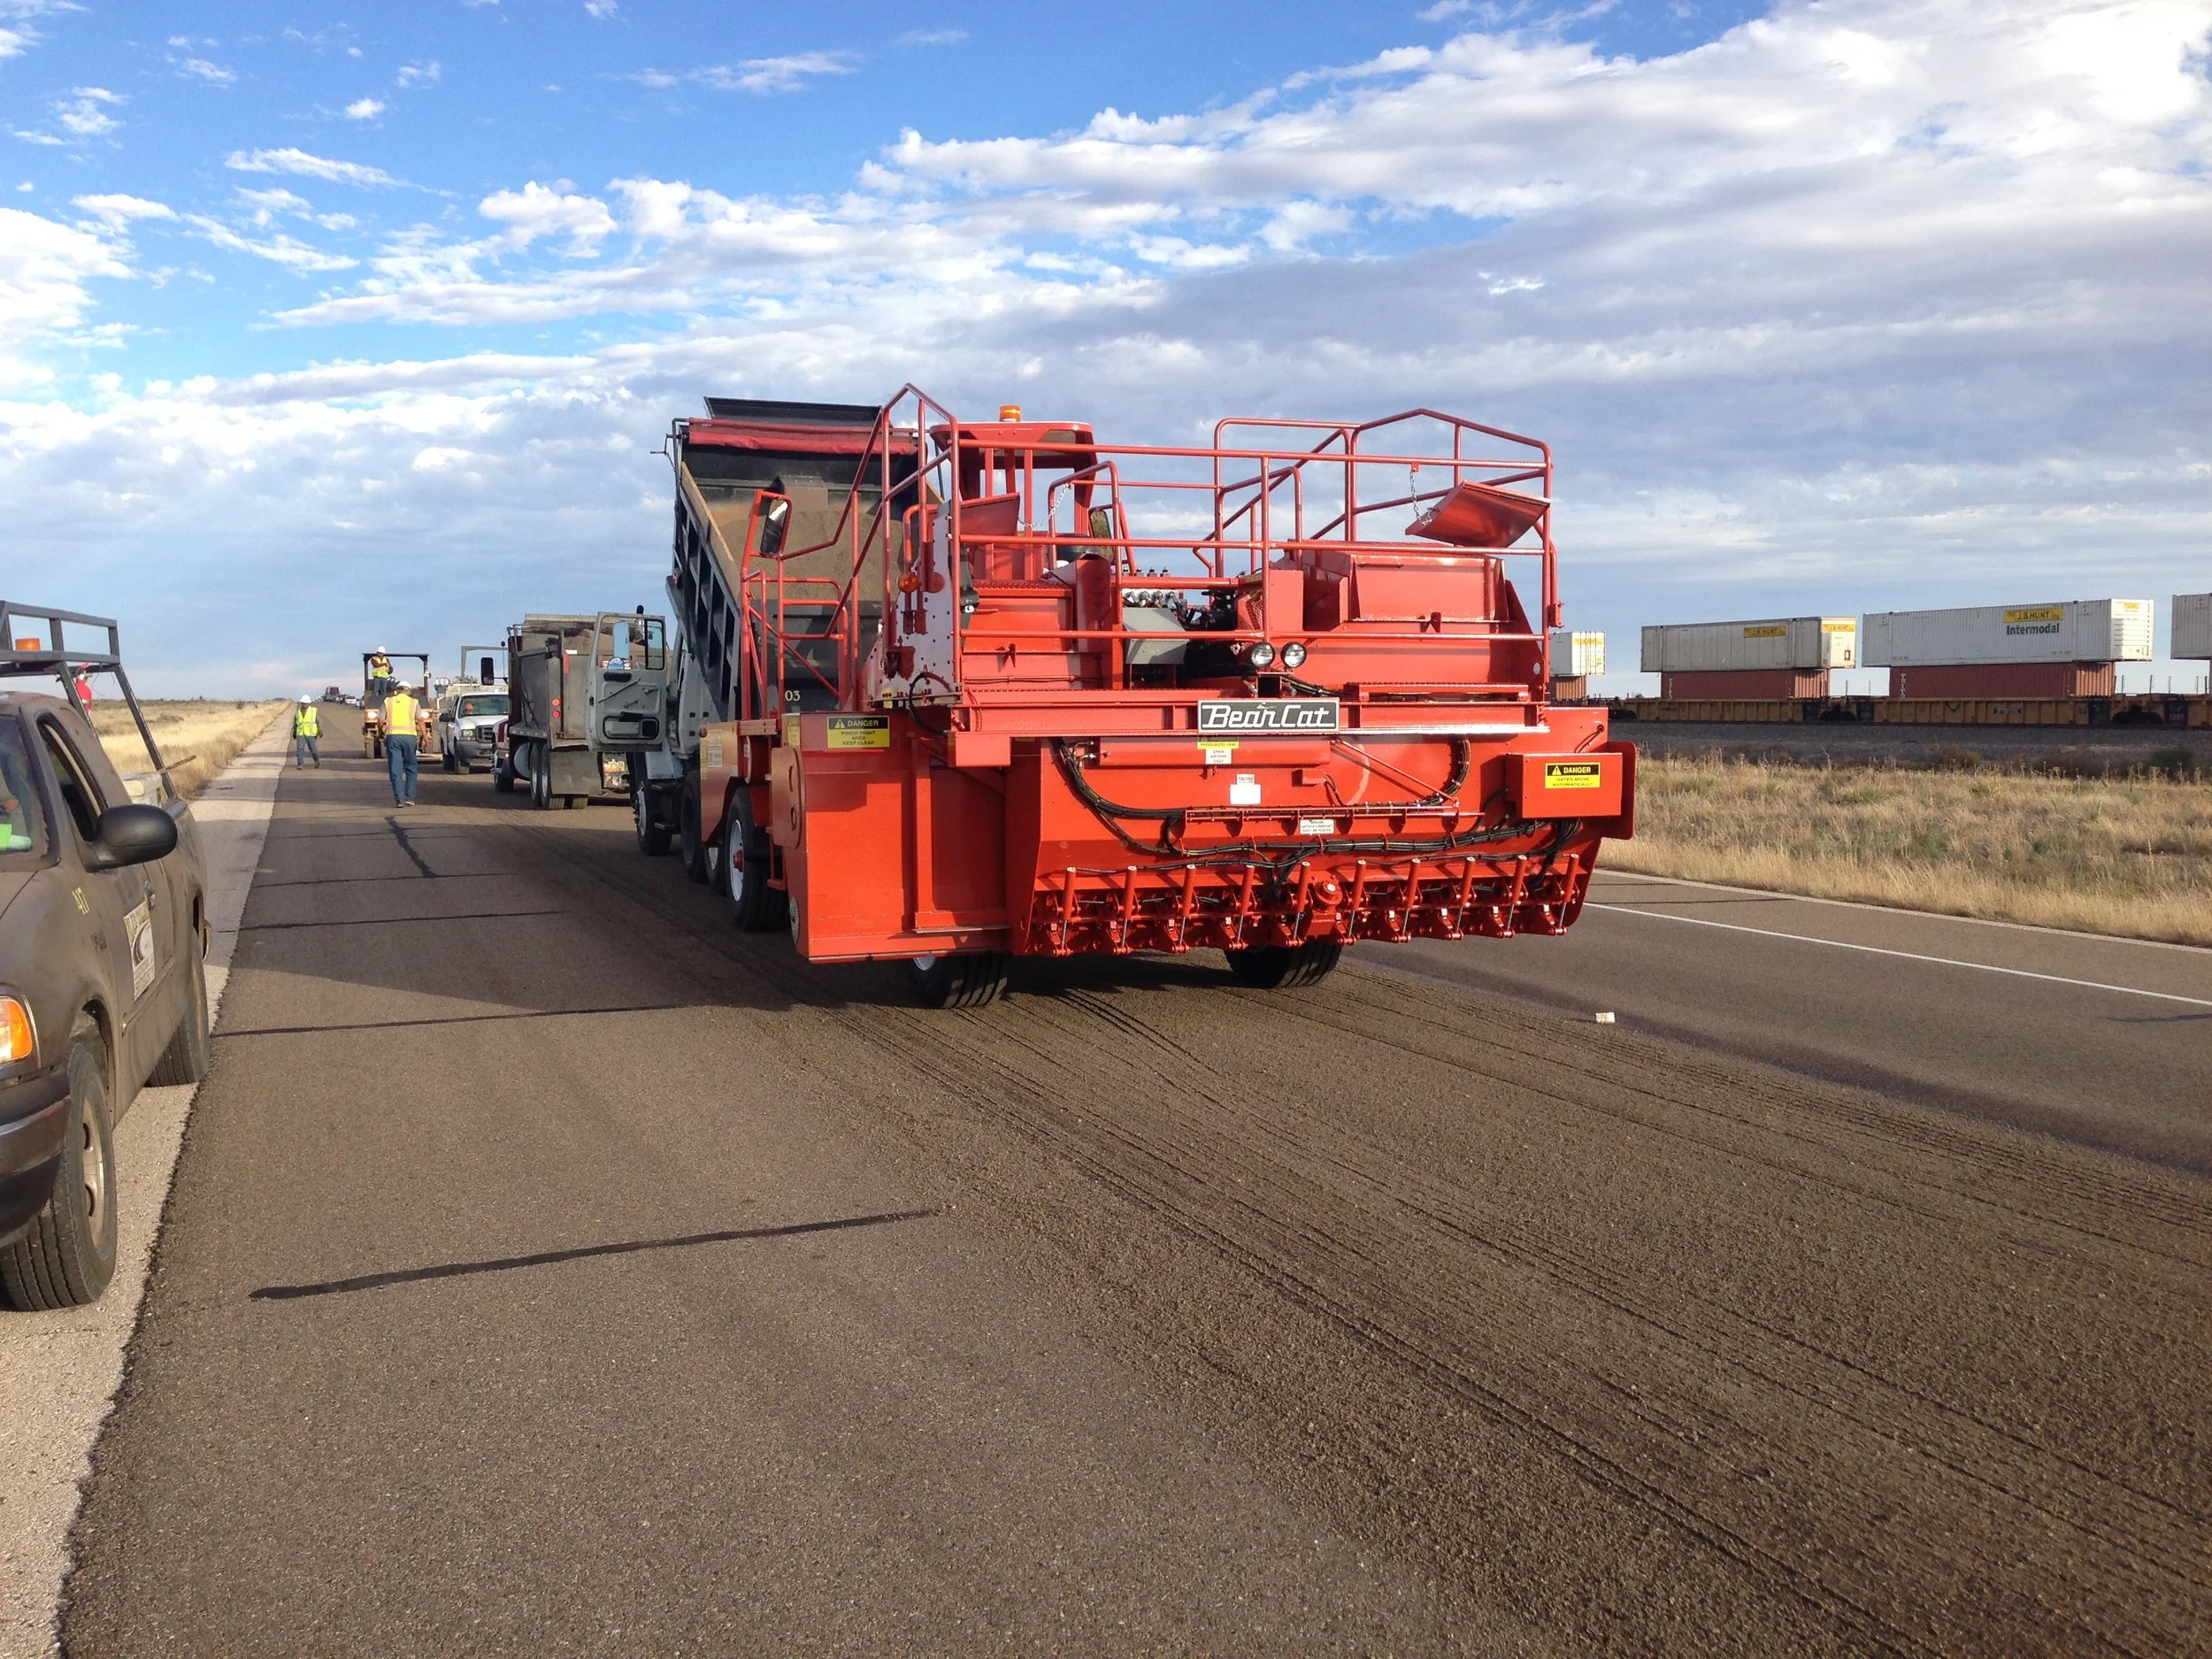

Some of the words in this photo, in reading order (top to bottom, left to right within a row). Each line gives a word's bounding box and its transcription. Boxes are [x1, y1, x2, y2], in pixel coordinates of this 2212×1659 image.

[2006, 623, 2060, 635] Intermodal
[785, 690, 801, 702] 03
[1202, 704, 1280, 728] Bear
[1280, 704, 1335, 728] Cat
